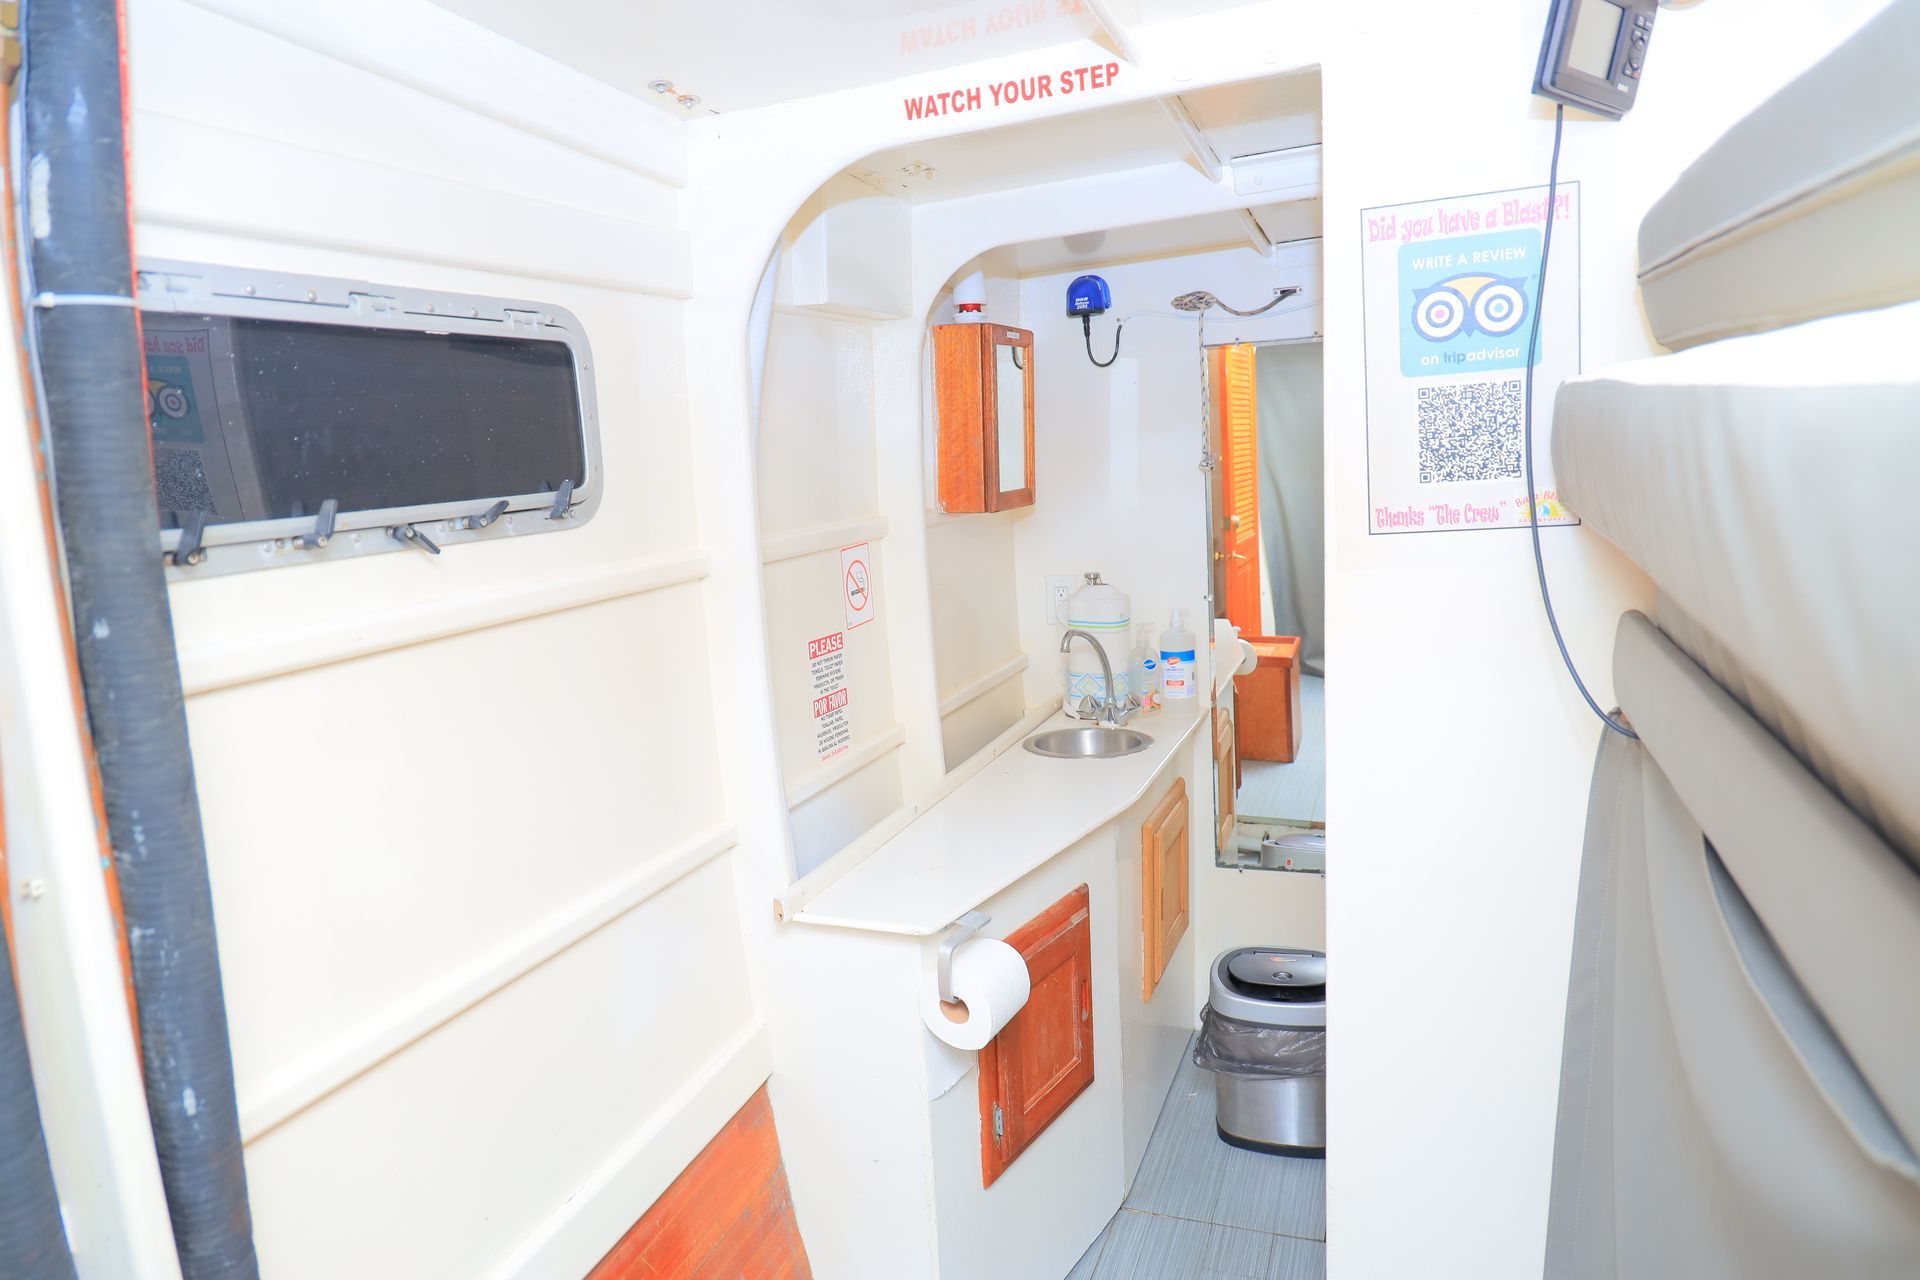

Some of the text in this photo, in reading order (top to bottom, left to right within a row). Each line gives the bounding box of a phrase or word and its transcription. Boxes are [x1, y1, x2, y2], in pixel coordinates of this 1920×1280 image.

[904, 62, 1120, 121] WATCH YOUR STEP
[1368, 215, 1397, 243] Did
[1401, 217, 1432, 244] you
[1437, 208, 1481, 235] have
[1485, 207, 1497, 229] a
[1411, 246, 1528, 271] WRITE A REVIEW
[1420, 347, 1520, 366] on tripadvisor
[1375, 506, 1425, 528] Thanks
[810, 634, 843, 658] PLEASE
[814, 690, 846, 716] POR FAVOR
